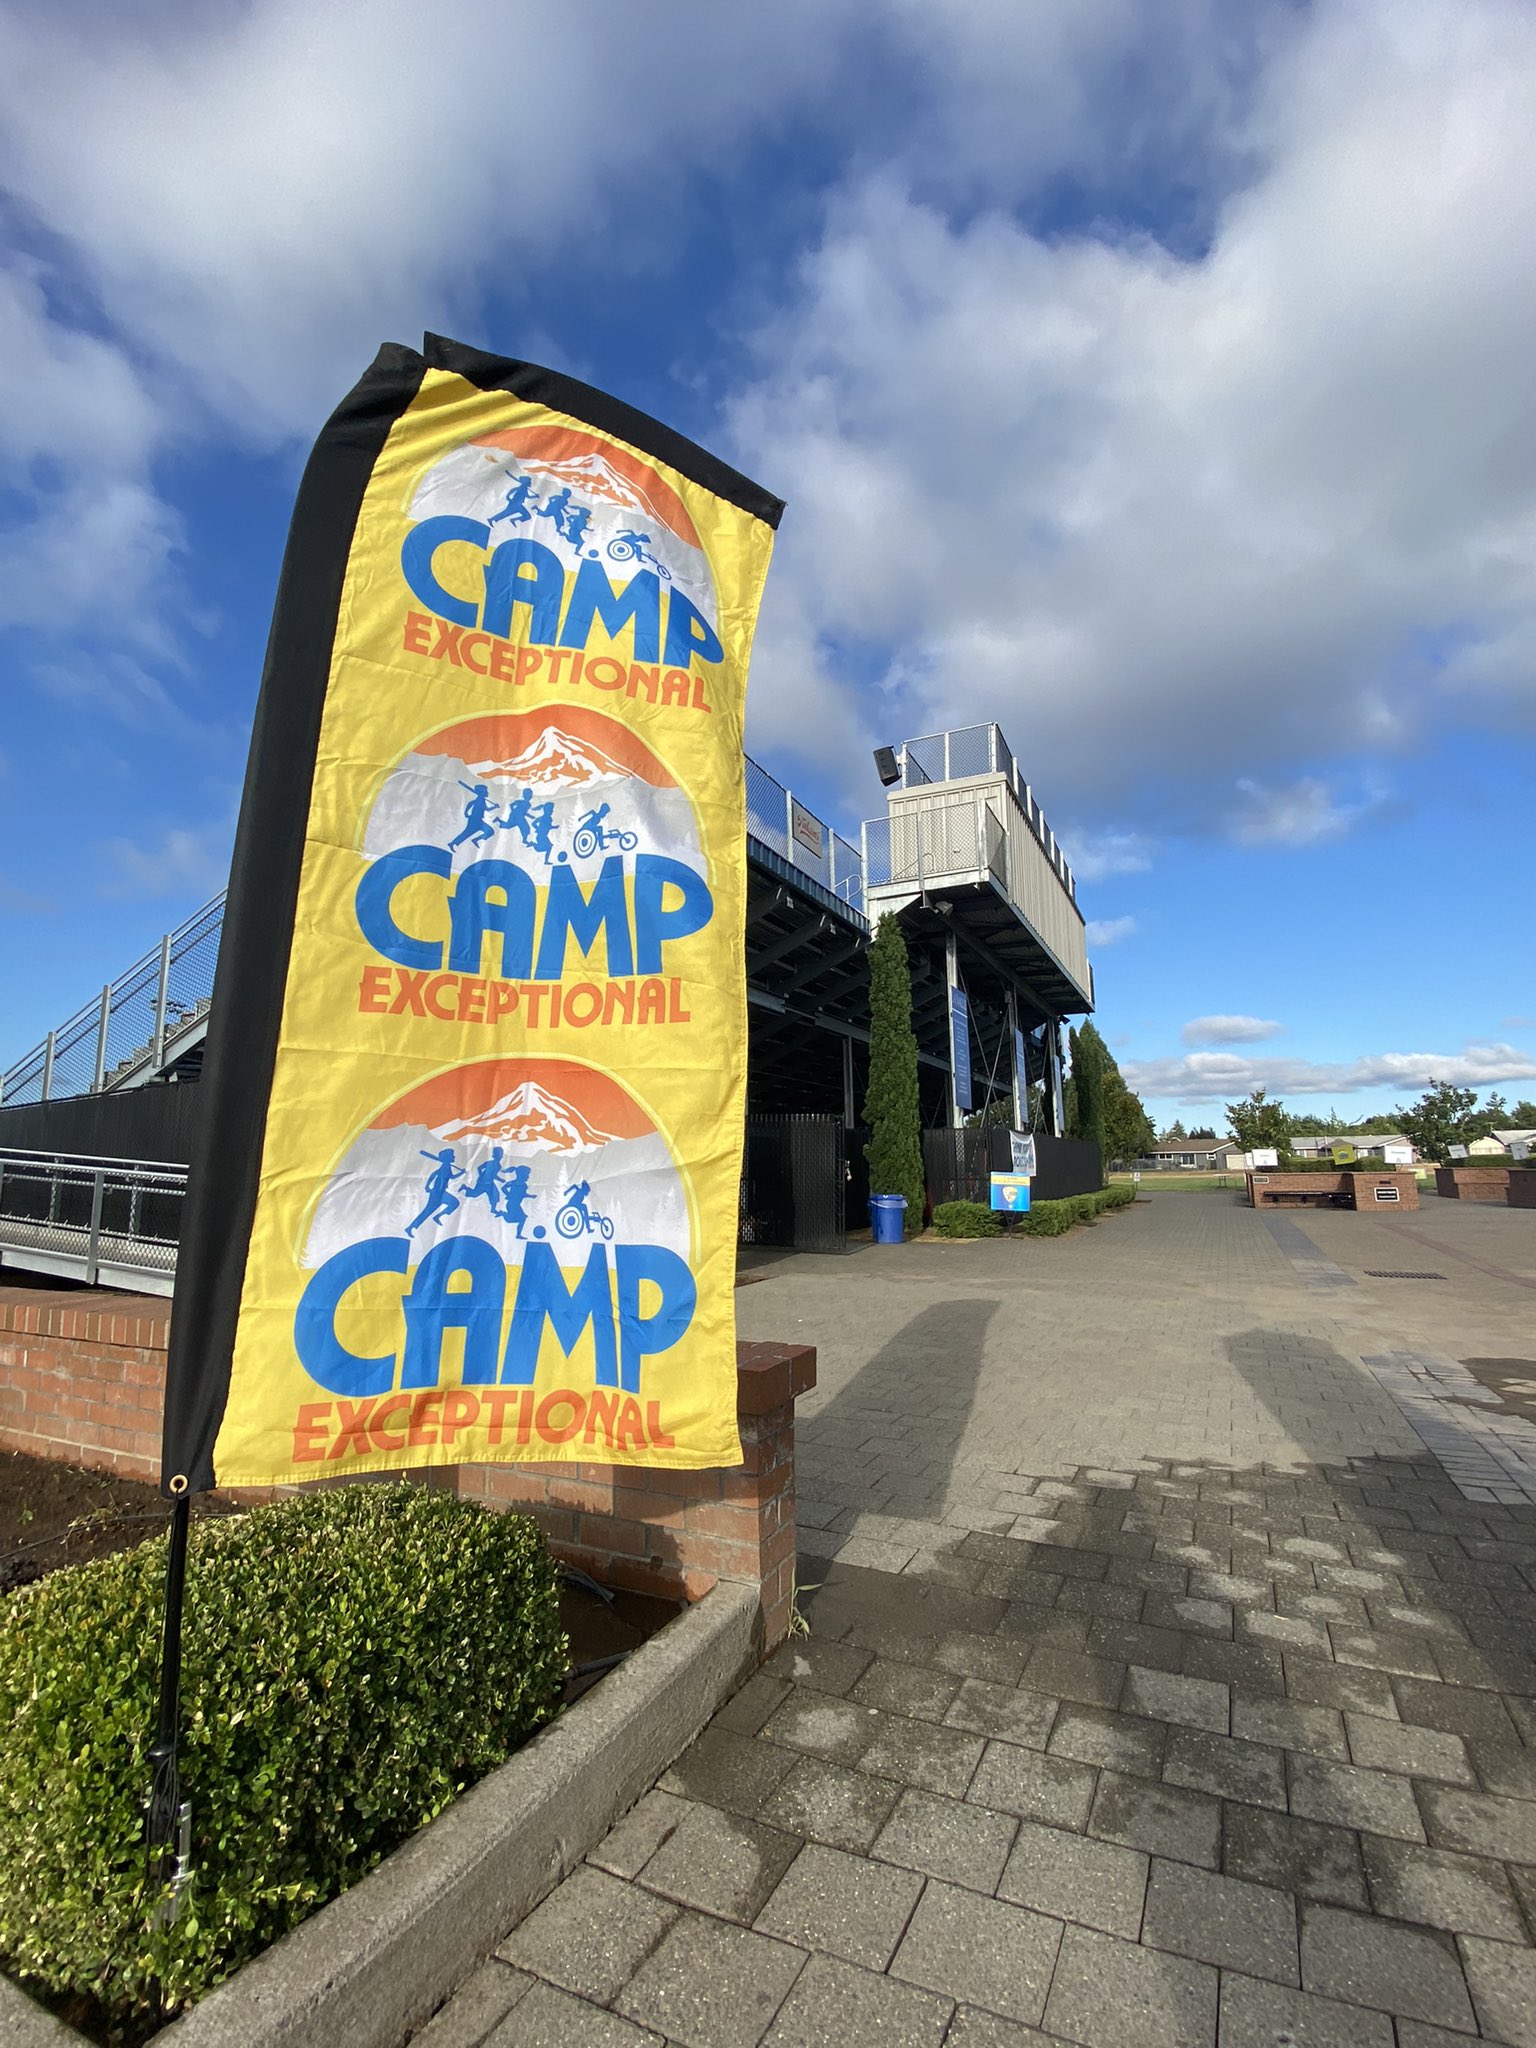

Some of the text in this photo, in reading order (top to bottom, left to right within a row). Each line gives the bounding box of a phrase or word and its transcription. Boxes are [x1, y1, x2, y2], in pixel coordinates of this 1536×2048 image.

[401, 515, 724, 669] CAMP
[403, 611, 712, 714] EXCEPTIONAL
[355, 844, 713, 980] CAMP
[358, 965, 691, 1028] EXCEPTIONAL
[293, 1235, 698, 1397] CAMP
[292, 1390, 675, 1463] EXCEPTIONAL
